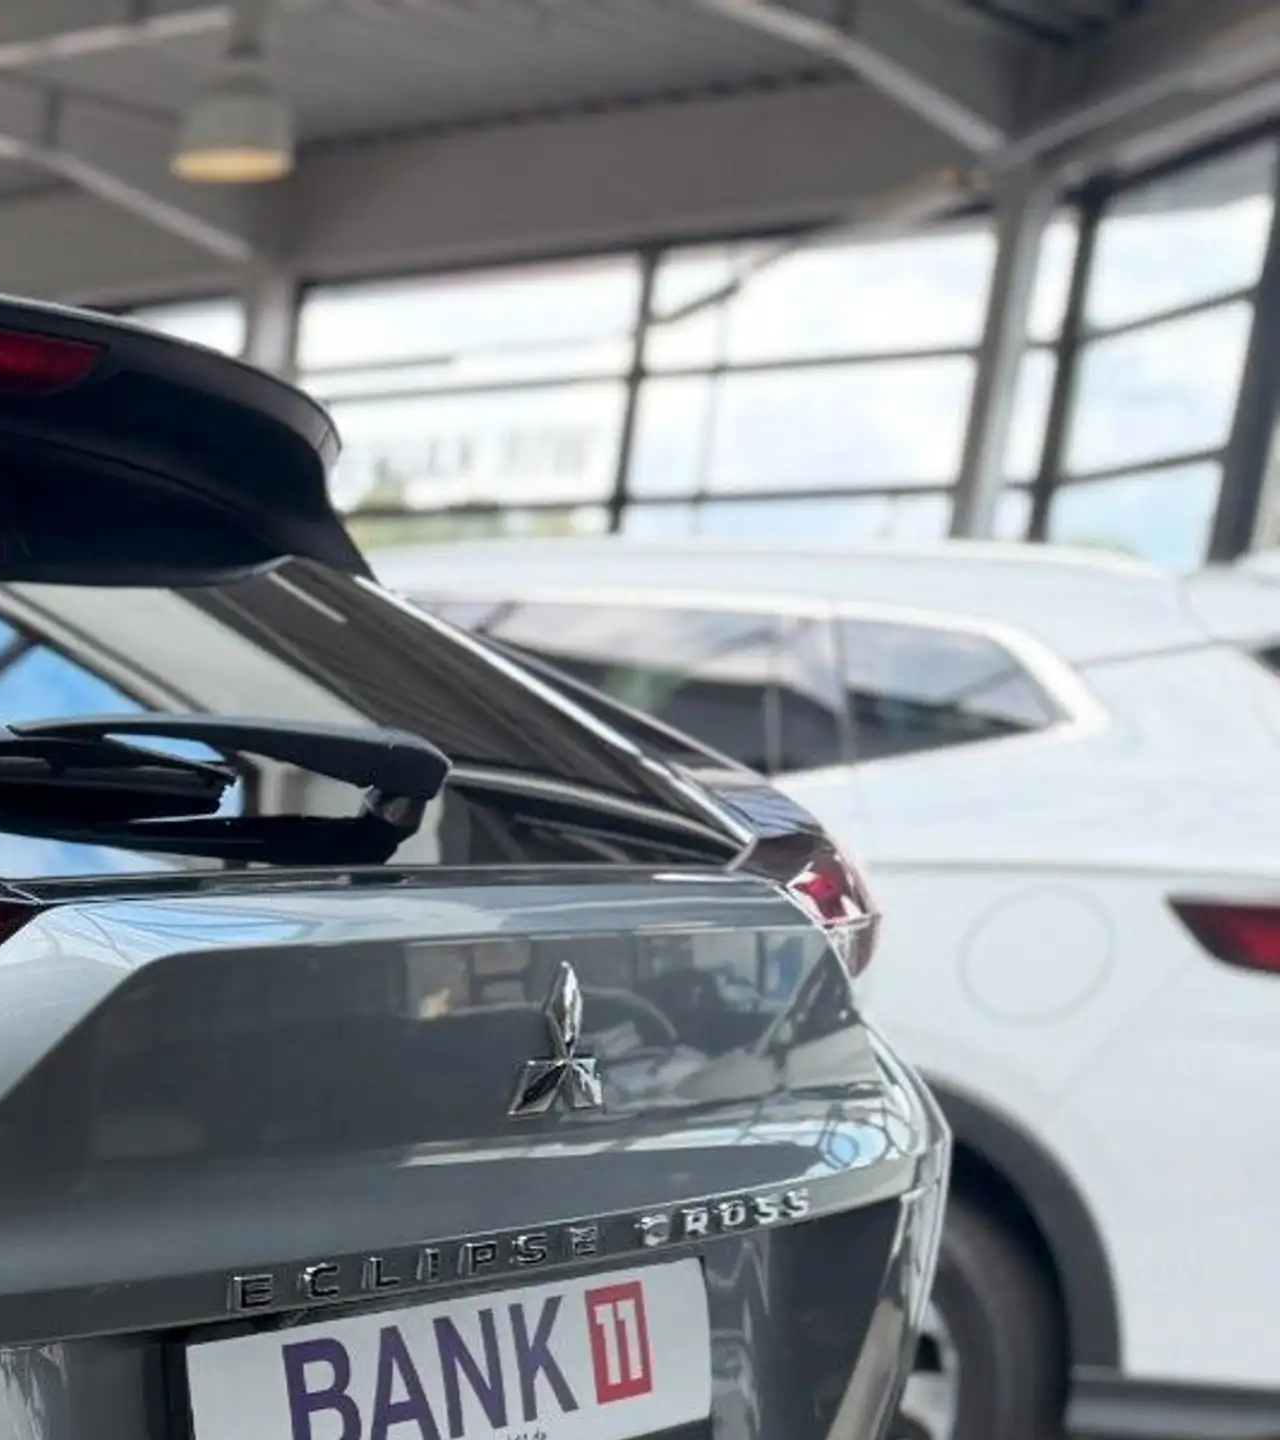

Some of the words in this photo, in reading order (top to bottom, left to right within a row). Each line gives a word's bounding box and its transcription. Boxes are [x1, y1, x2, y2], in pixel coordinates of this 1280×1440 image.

[232, 1226, 598, 1309] ECLIPSE
[635, 1190, 811, 1246] CROSS
[592, 1295, 646, 1390] 11
